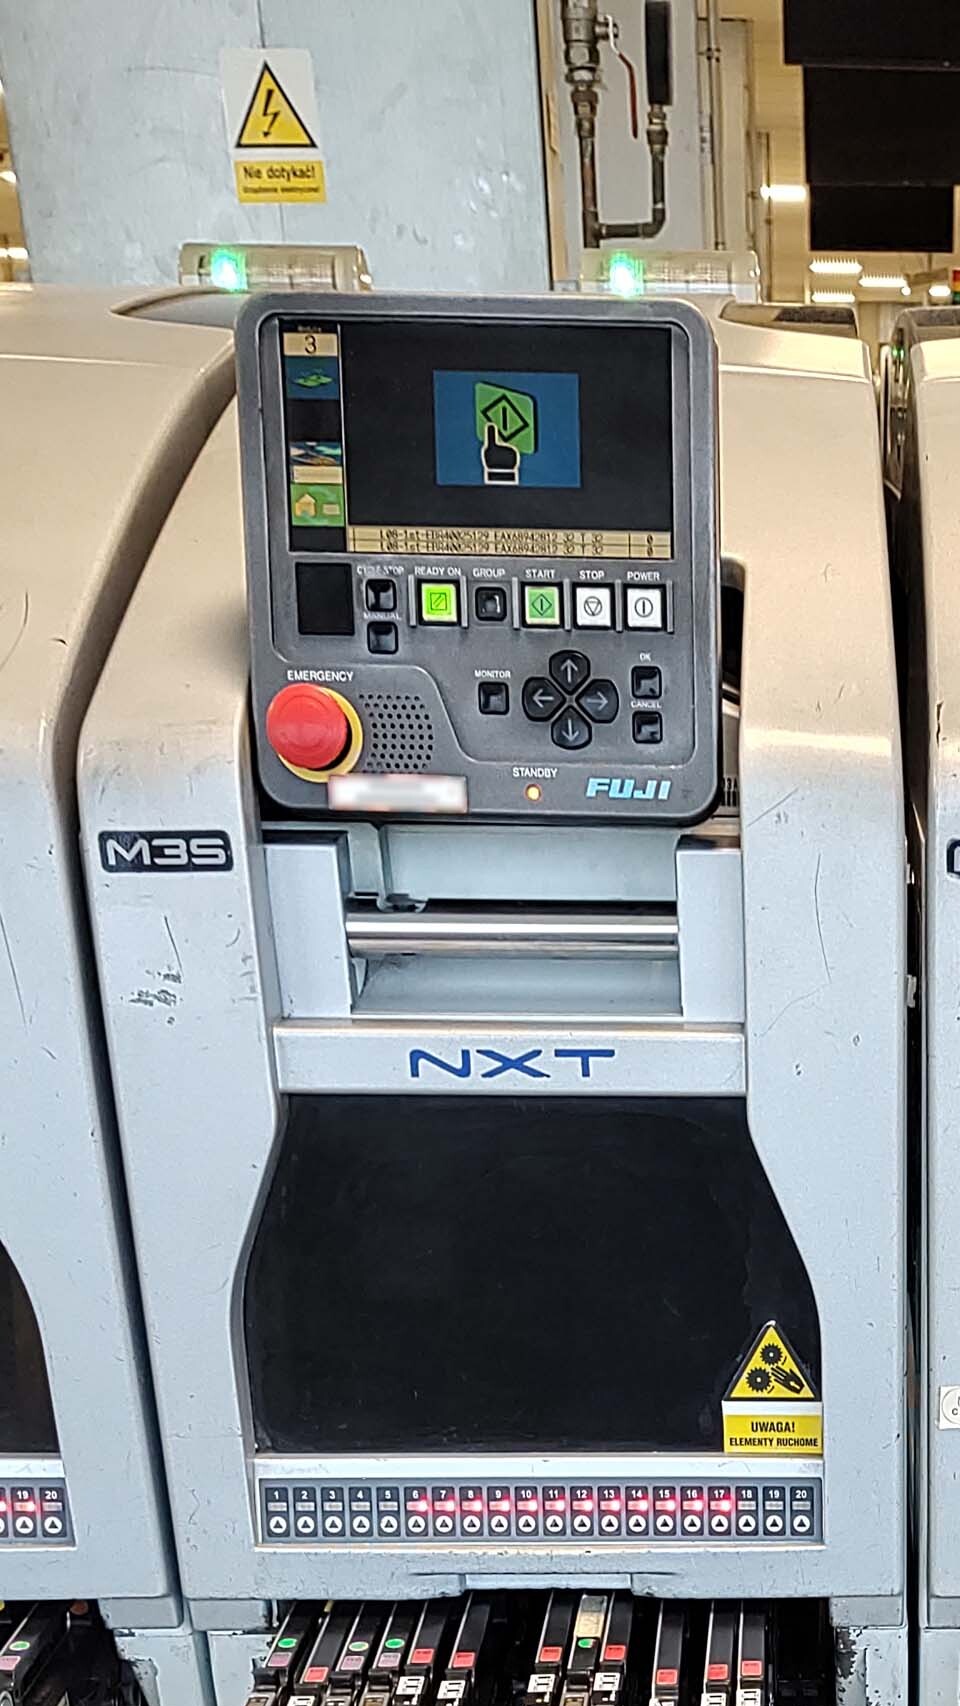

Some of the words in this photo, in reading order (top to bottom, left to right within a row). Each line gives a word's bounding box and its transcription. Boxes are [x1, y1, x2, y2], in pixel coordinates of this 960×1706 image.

[243, 166, 262, 178] Nie
[305, 334, 317, 354] 3
[414, 566, 445, 576] READY
[447, 566, 461, 576] ON
[473, 567, 505, 577] GROUP
[525, 569, 555, 579] START
[579, 570, 604, 580] STOP
[627, 571, 660, 581] POWER
[287, 670, 354, 682] EMERGENCY
[474, 669, 511, 679] MONITOR
[630, 699, 662, 709] CANCEL
[512, 767, 558, 779] STANDBY
[585, 777, 672, 800] FUJI
[106, 838, 228, 867] M3S
[409, 1048, 616, 1080] NXT
[751, 1421, 795, 1433] UWAGA!
[729, 1438, 774, 1447] ELEMENTY
[776, 1438, 819, 1447] RUCHOME
[17, 1491, 28, 1499] 19
[45, 1491, 57, 1499] 20
[520, 1489, 532, 1499] 10
[548, 1489, 559, 1499] 11
[576, 1489, 588, 1499] 12
[603, 1489, 615, 1499] 13
[631, 1489, 643, 1499] 14
[658, 1489, 670, 1499] 15
[686, 1489, 698, 1499] 16
[713, 1489, 725, 1499] 17
[741, 1489, 753, 1499] 18
[768, 1489, 780, 1499] 19
[795, 1489, 807, 1499] 20
